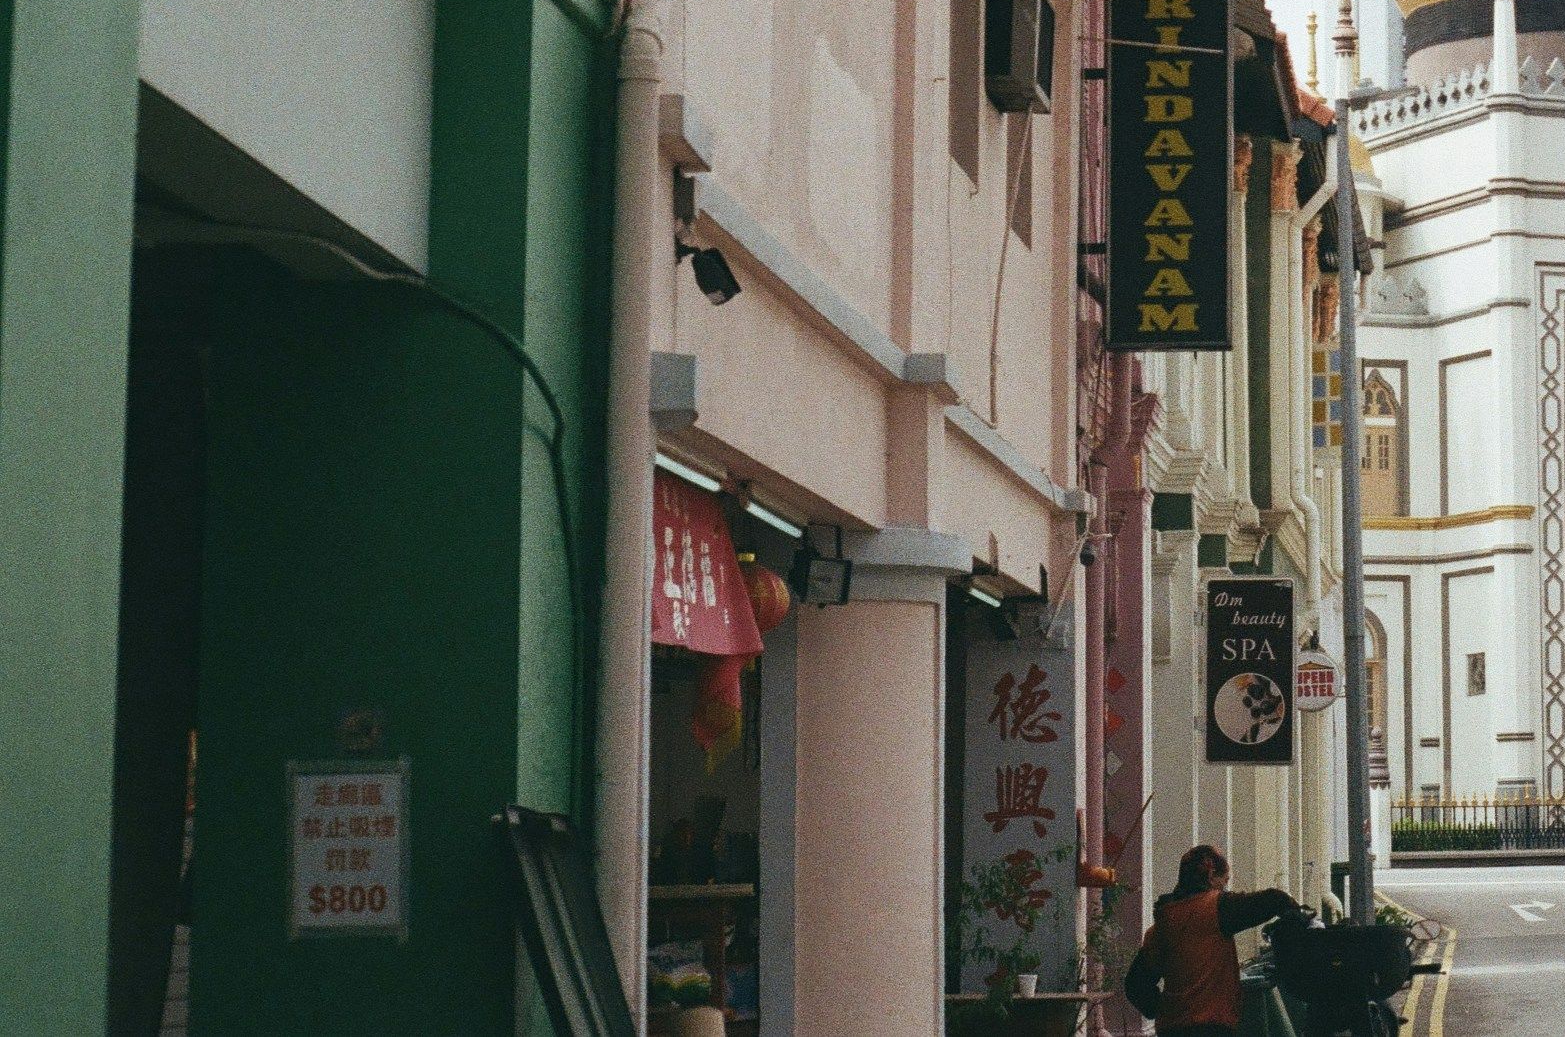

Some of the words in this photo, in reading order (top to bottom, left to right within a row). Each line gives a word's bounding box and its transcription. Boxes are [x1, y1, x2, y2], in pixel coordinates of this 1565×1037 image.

[1231, 610, 1287, 629] beauty
[1222, 638, 1276, 661] SPA
[1297, 684, 1335, 698] OSTEL
[308, 883, 388, 917] $800
